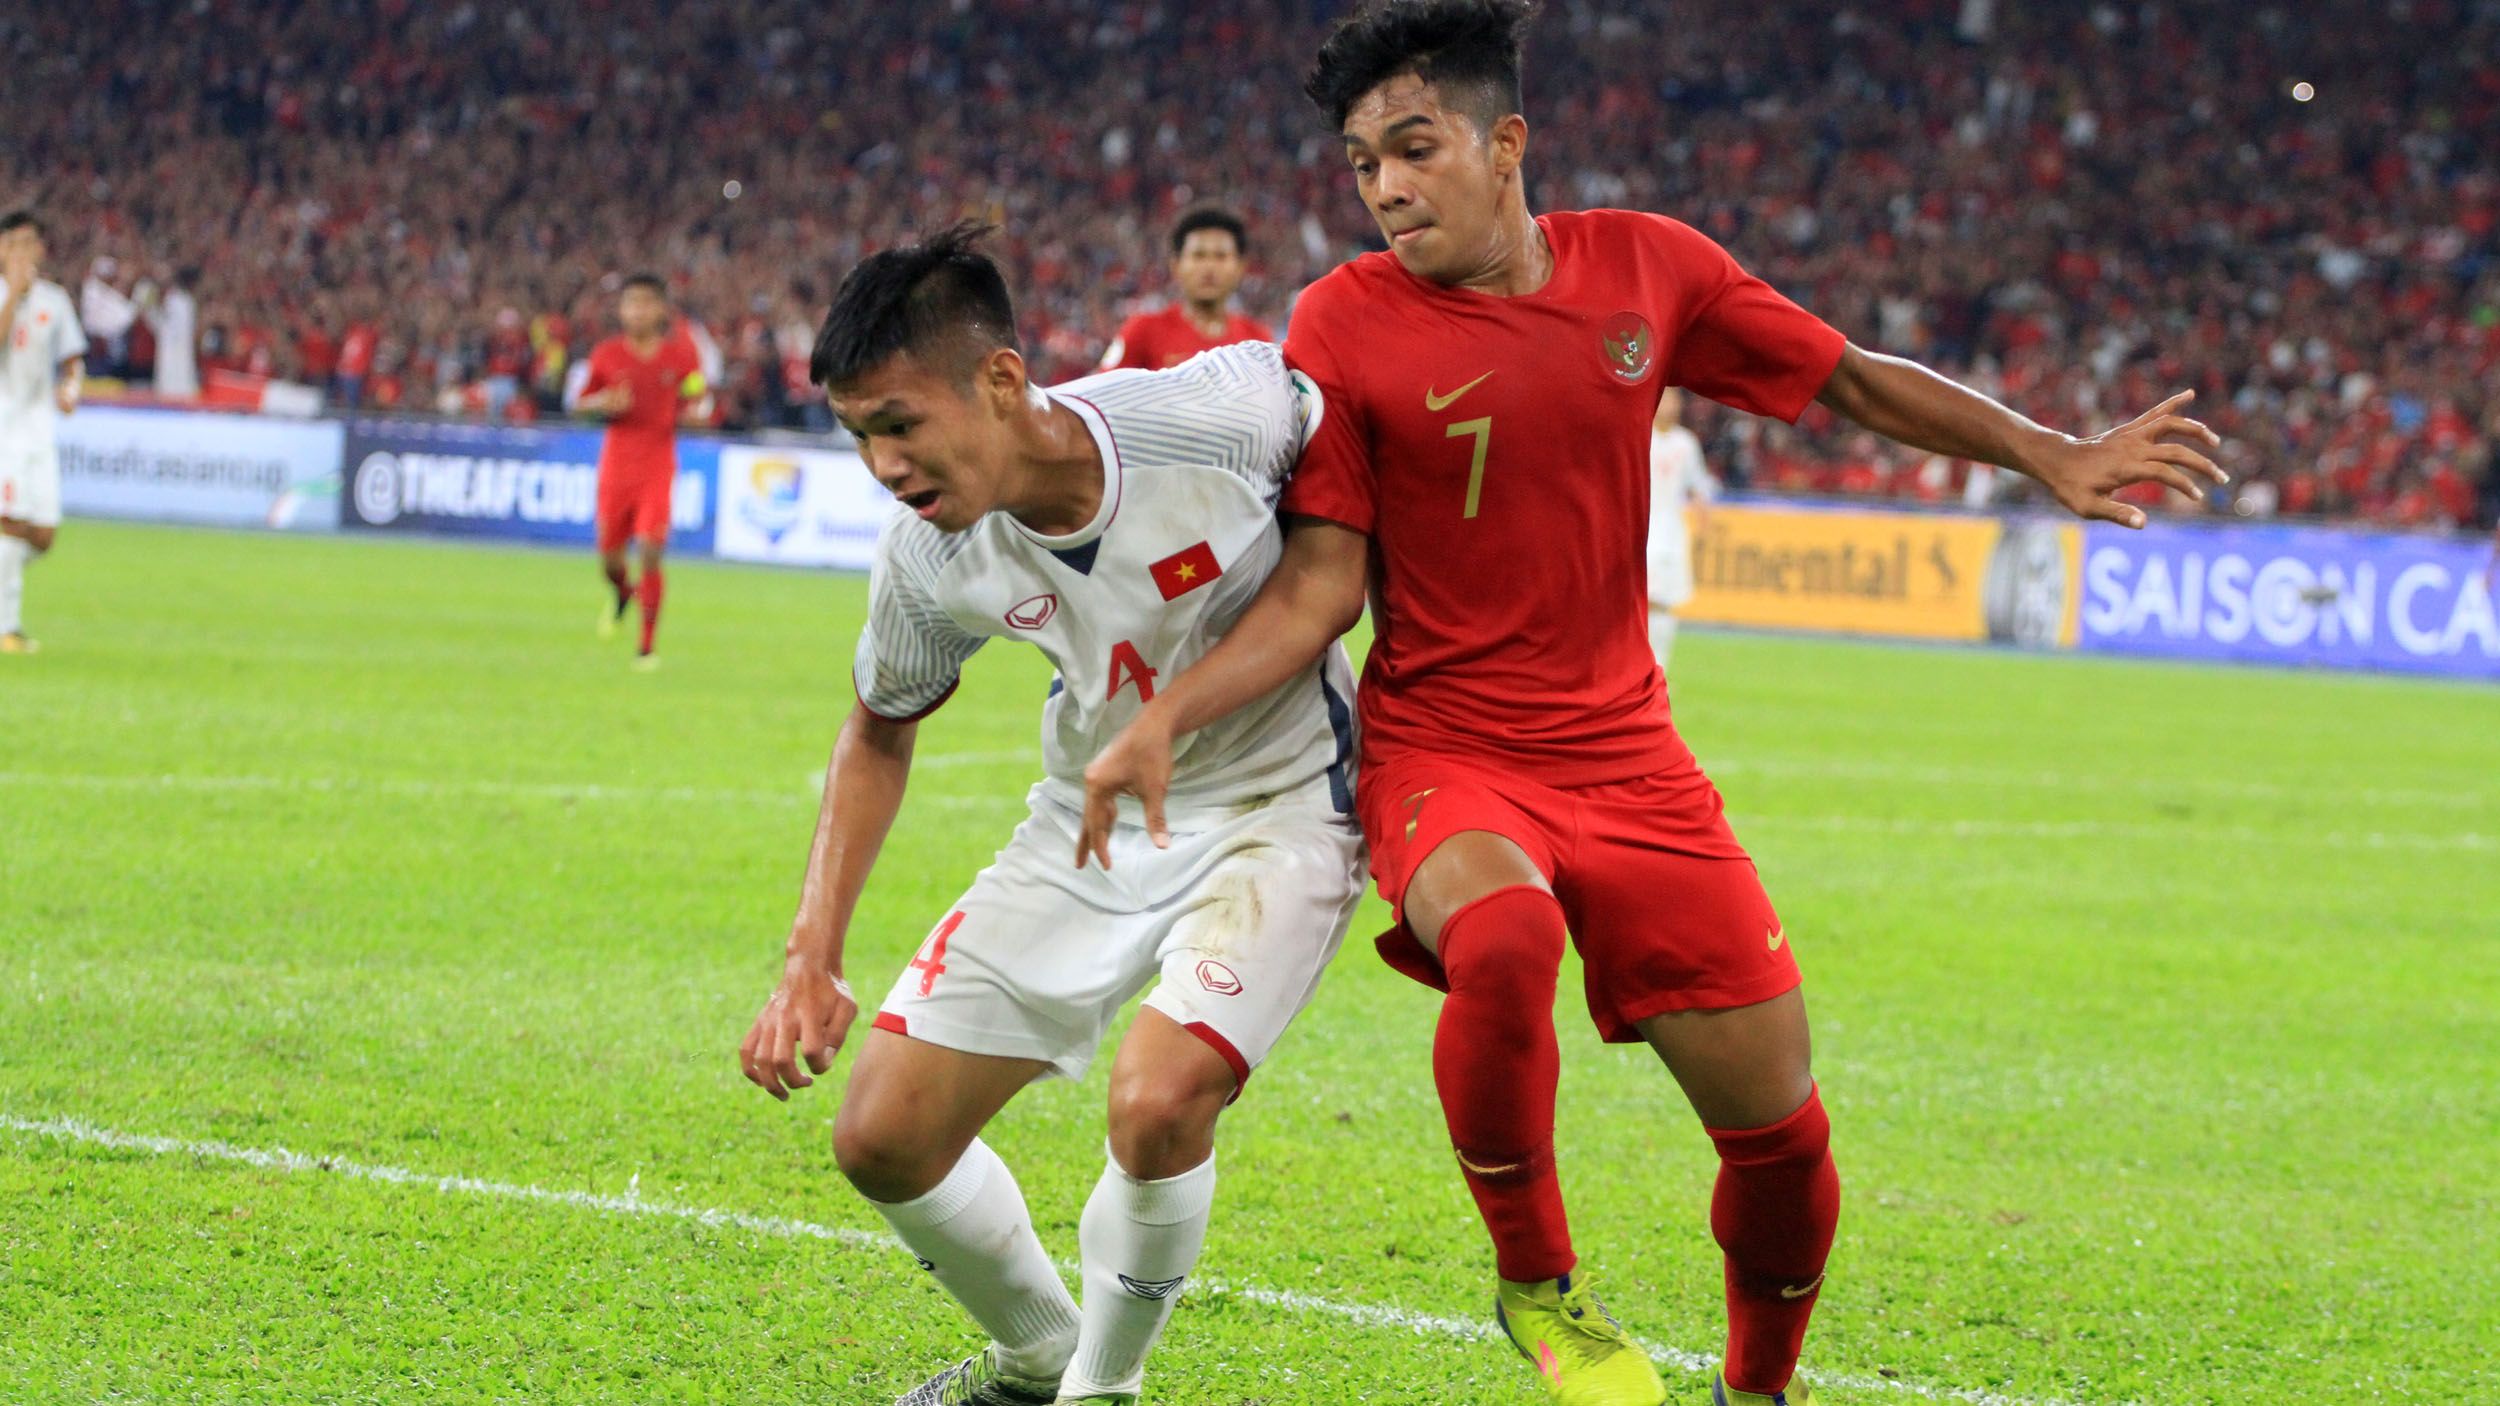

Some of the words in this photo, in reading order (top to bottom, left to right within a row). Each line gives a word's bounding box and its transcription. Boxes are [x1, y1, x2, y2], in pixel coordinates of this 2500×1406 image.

[1446, 416, 1491, 519] 7
[1692, 524, 1909, 598] tinental
[2084, 547, 2377, 648] SAISON
[1106, 639, 1158, 703] 4
[910, 910, 967, 998] 4
